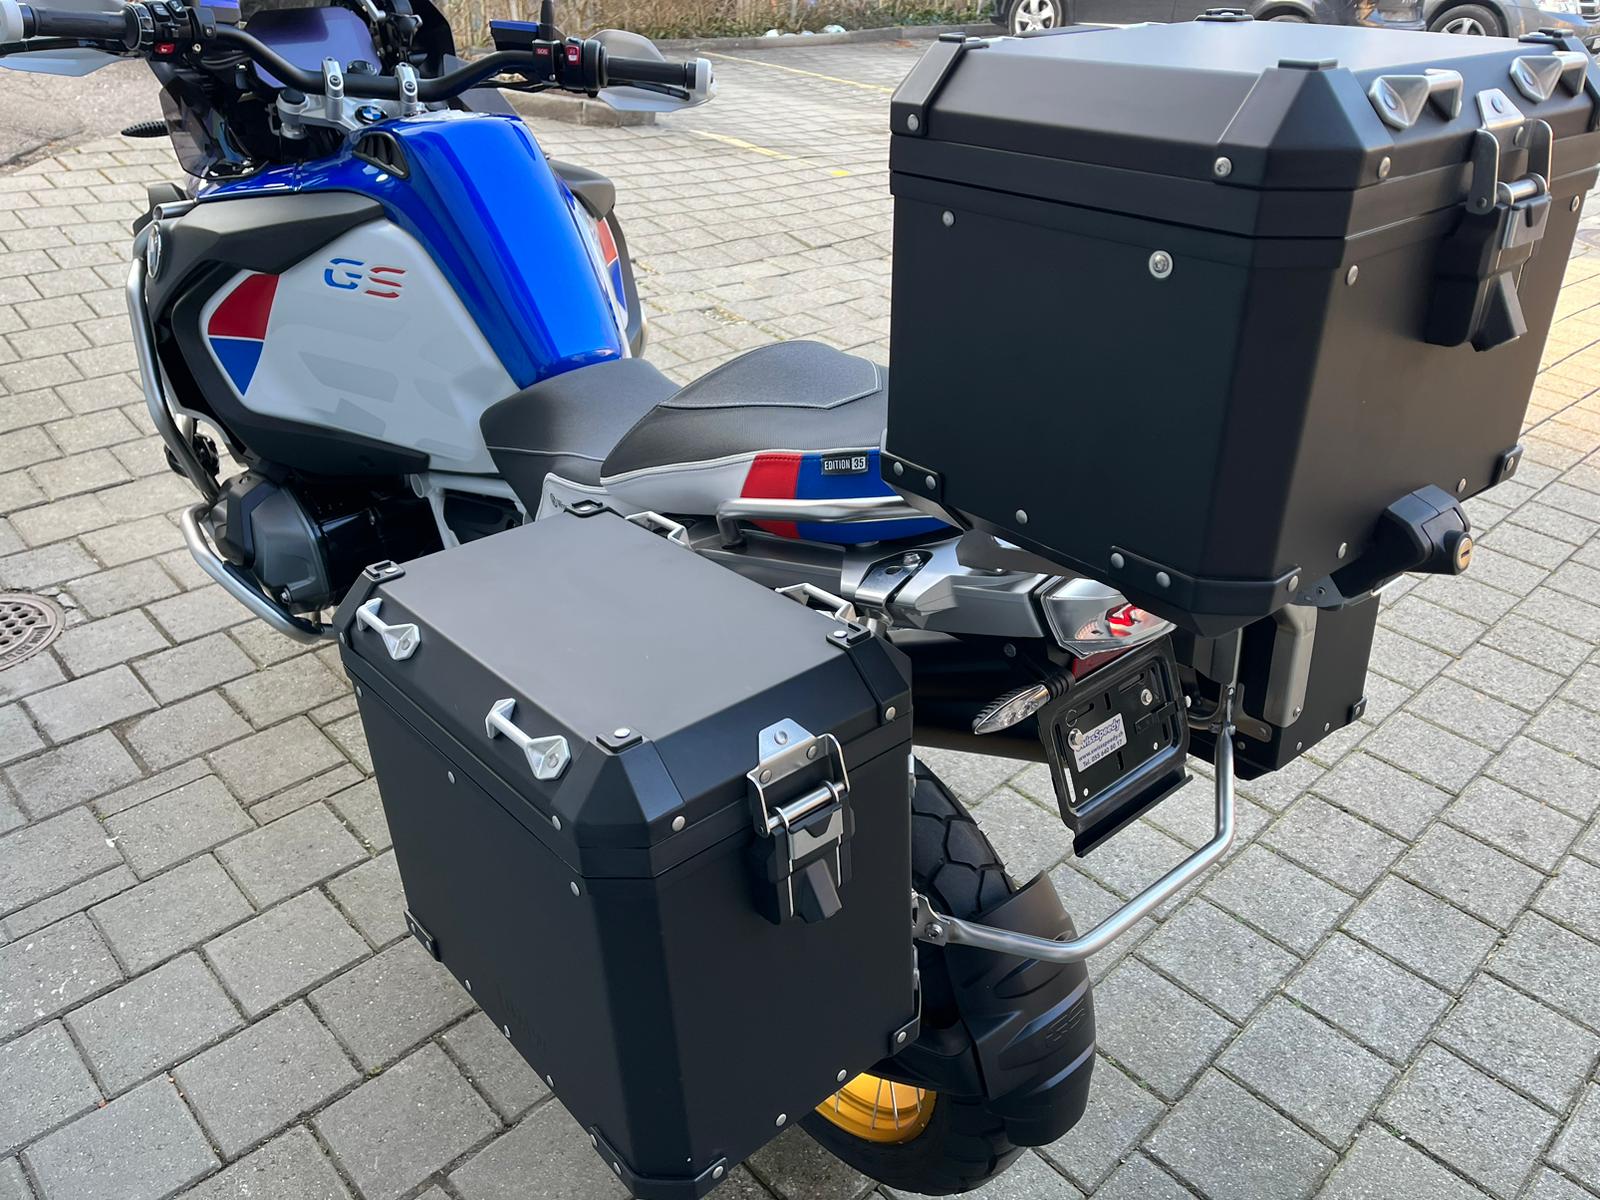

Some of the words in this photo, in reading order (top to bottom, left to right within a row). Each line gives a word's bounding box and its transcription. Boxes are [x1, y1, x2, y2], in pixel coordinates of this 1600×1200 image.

[324, 258, 406, 299] GS
[824, 459, 850, 470] EDITION
[853, 457, 865, 469] 35
